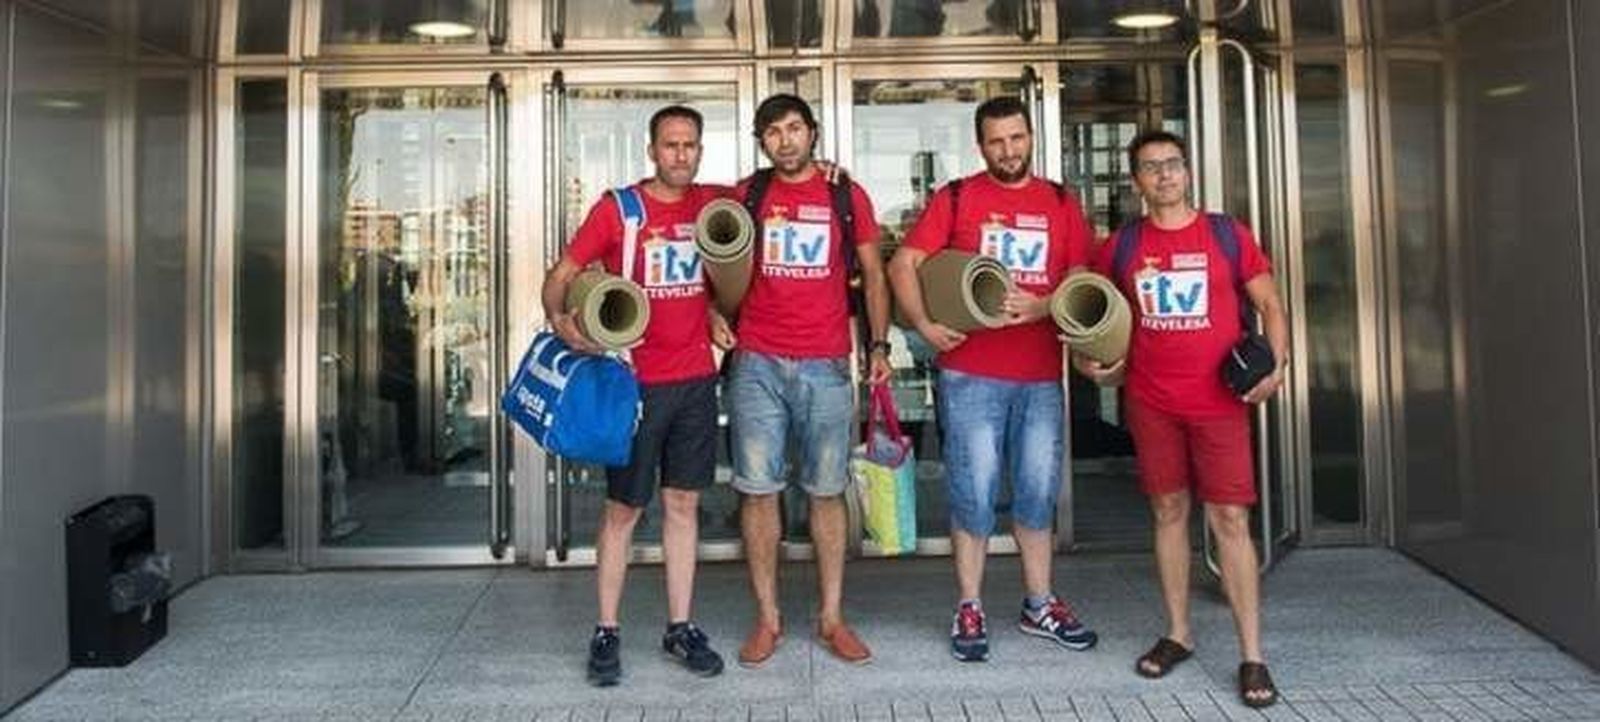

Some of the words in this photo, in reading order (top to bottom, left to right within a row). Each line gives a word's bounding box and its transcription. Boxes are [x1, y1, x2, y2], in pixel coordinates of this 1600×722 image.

[770, 226, 824, 263] itv
[988, 231, 1043, 268] itv
[651, 245, 701, 282] itv
[762, 265, 831, 279] ITEVELESA
[1009, 271, 1049, 285] ELESA
[1141, 276, 1203, 315] itv
[1141, 316, 1212, 331] ITEVELESA
